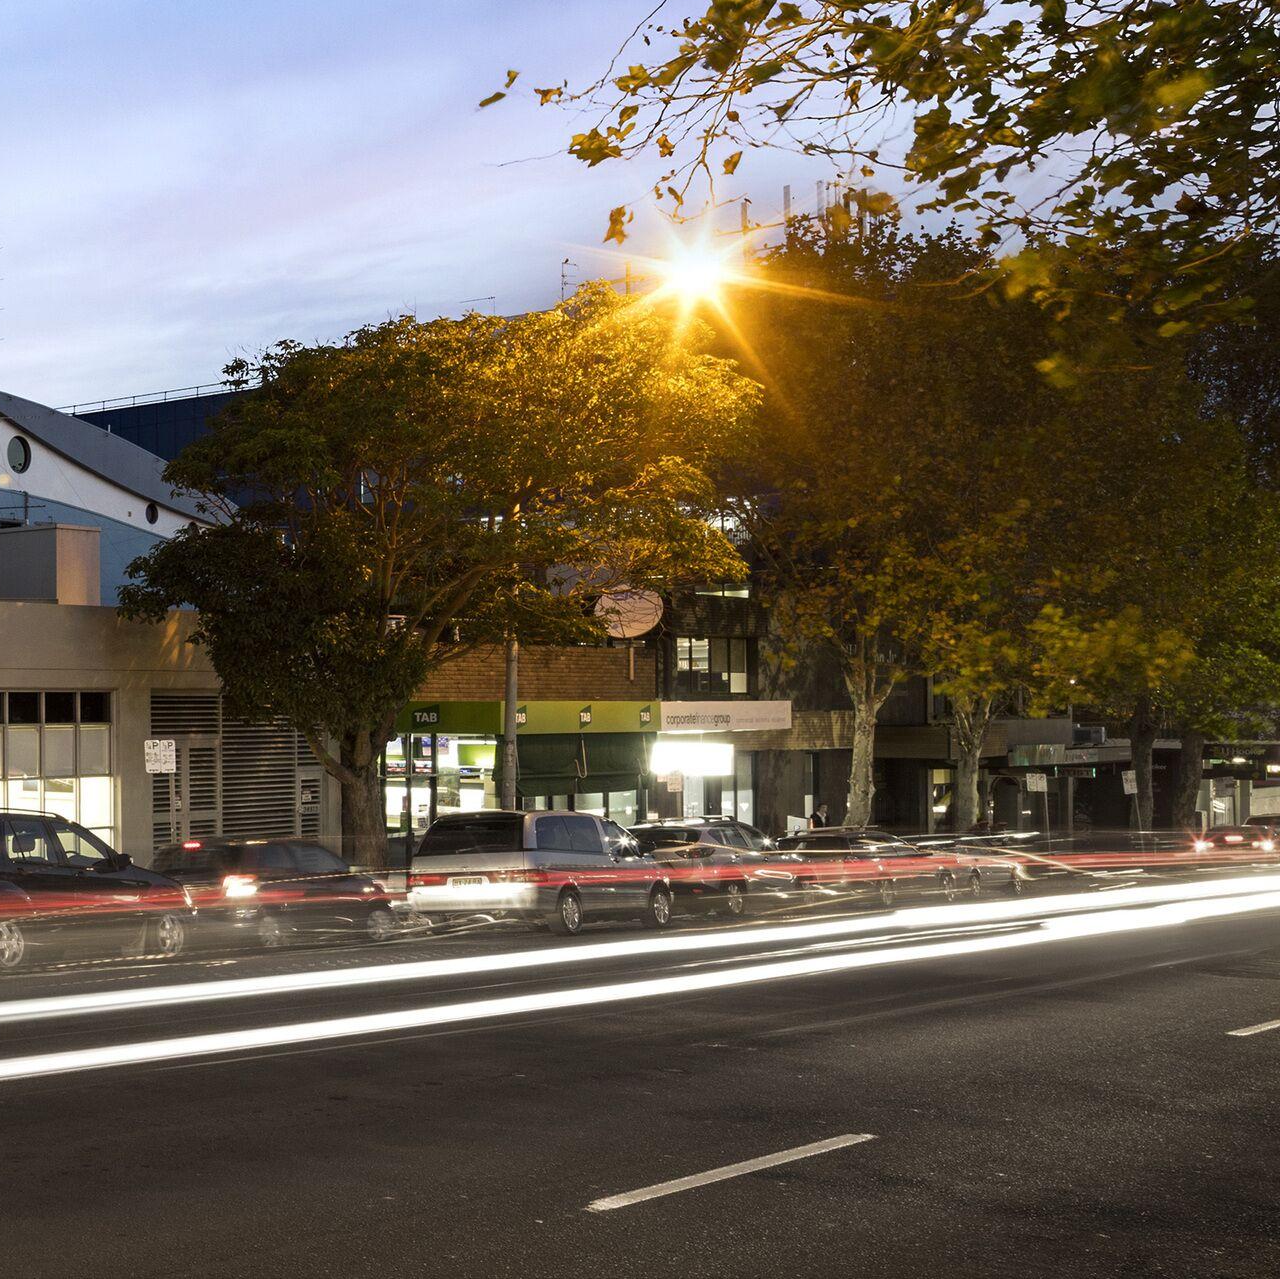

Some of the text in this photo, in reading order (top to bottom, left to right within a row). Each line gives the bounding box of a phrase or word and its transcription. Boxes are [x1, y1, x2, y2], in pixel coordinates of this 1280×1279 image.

[413, 711, 439, 723] TAB
[580, 711, 592, 723] TAB
[640, 711, 651, 723] TAB
